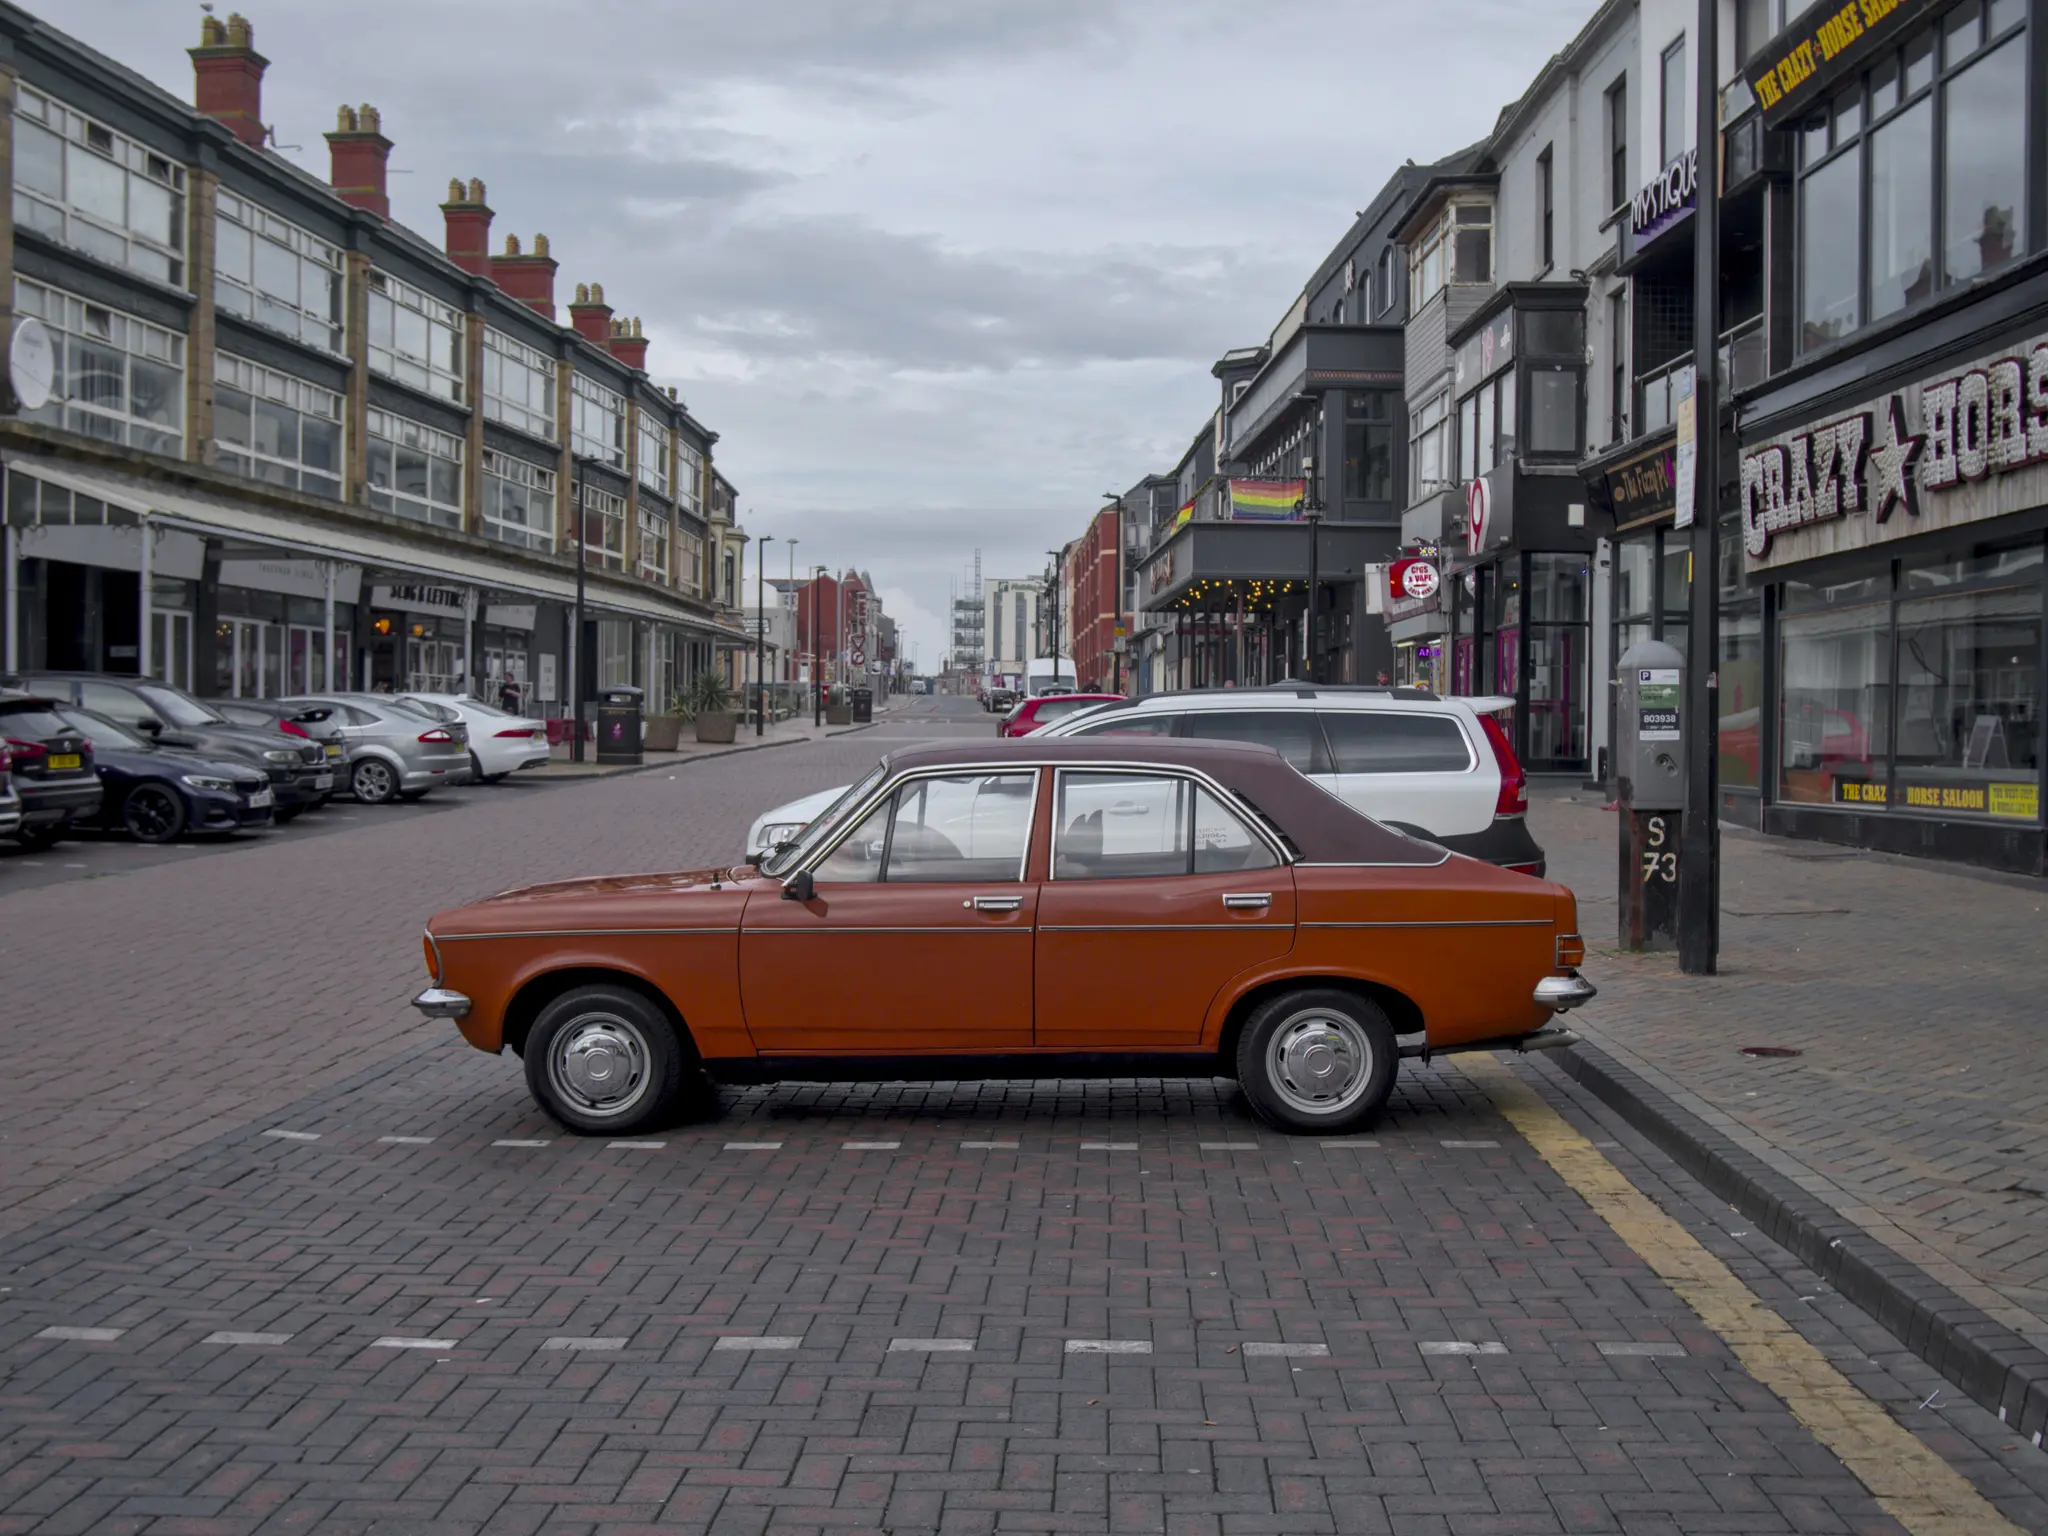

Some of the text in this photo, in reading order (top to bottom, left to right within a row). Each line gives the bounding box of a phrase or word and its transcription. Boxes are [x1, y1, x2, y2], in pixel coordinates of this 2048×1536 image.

[1754, 68, 1783, 111] THE
[1776, 38, 1818, 95] CRAZY
[1815, 3, 1865, 62] HORSE
[1742, 412, 1868, 557] CRAZY
[1466, 477, 1491, 556] 19
[1411, 566, 1428, 574] CIGS
[1414, 574, 1432, 582] VAPE
[1644, 714, 1676, 722] 803938
[1843, 783, 1860, 800] THE
[1862, 784, 1887, 802] CRAZ
[1907, 786, 1940, 805] HORSE
[1943, 788, 1984, 809] SALOON
[1648, 816, 1665, 846] S
[1643, 852, 1676, 882] 73
